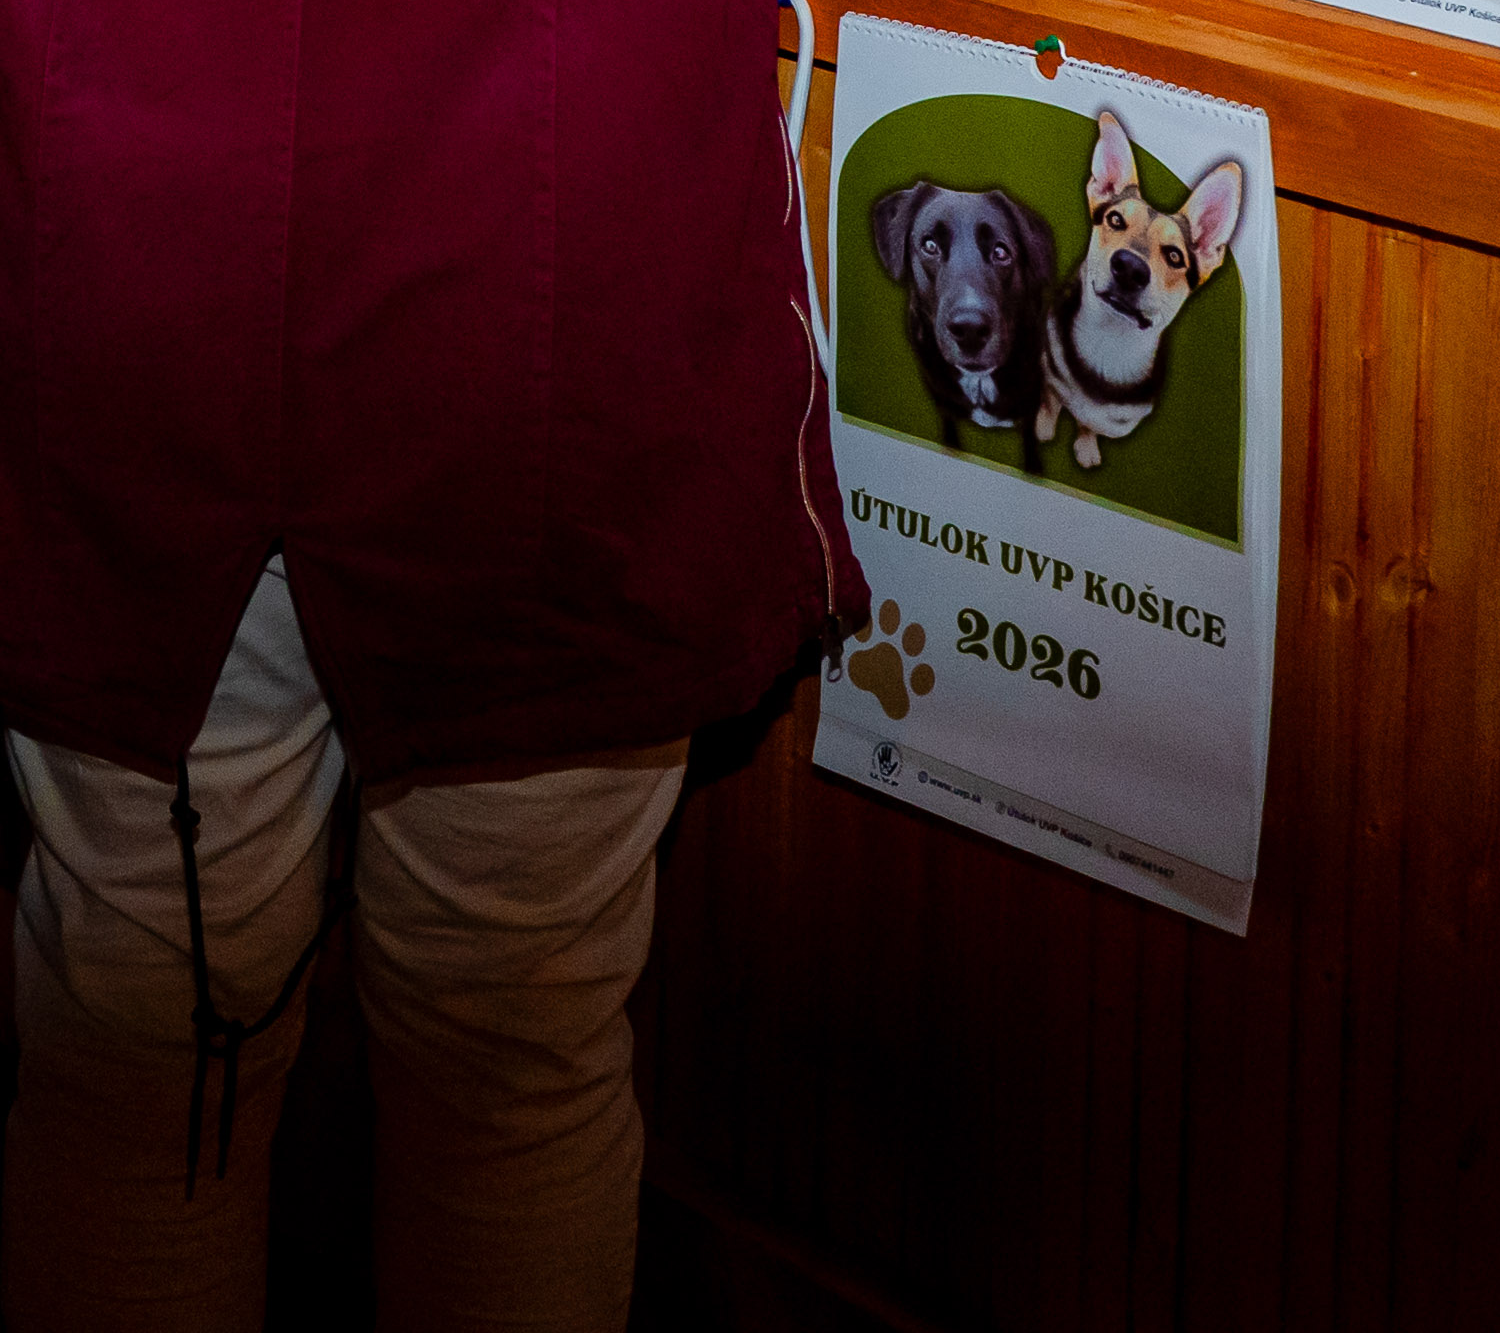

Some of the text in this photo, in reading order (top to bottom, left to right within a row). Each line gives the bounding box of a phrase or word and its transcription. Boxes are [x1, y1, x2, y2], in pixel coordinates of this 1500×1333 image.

[1444, 1, 1467, 15] UVP
[850, 487, 1226, 649] ÚTULOK UVP KOŠICE
[956, 607, 1101, 701] 2026
